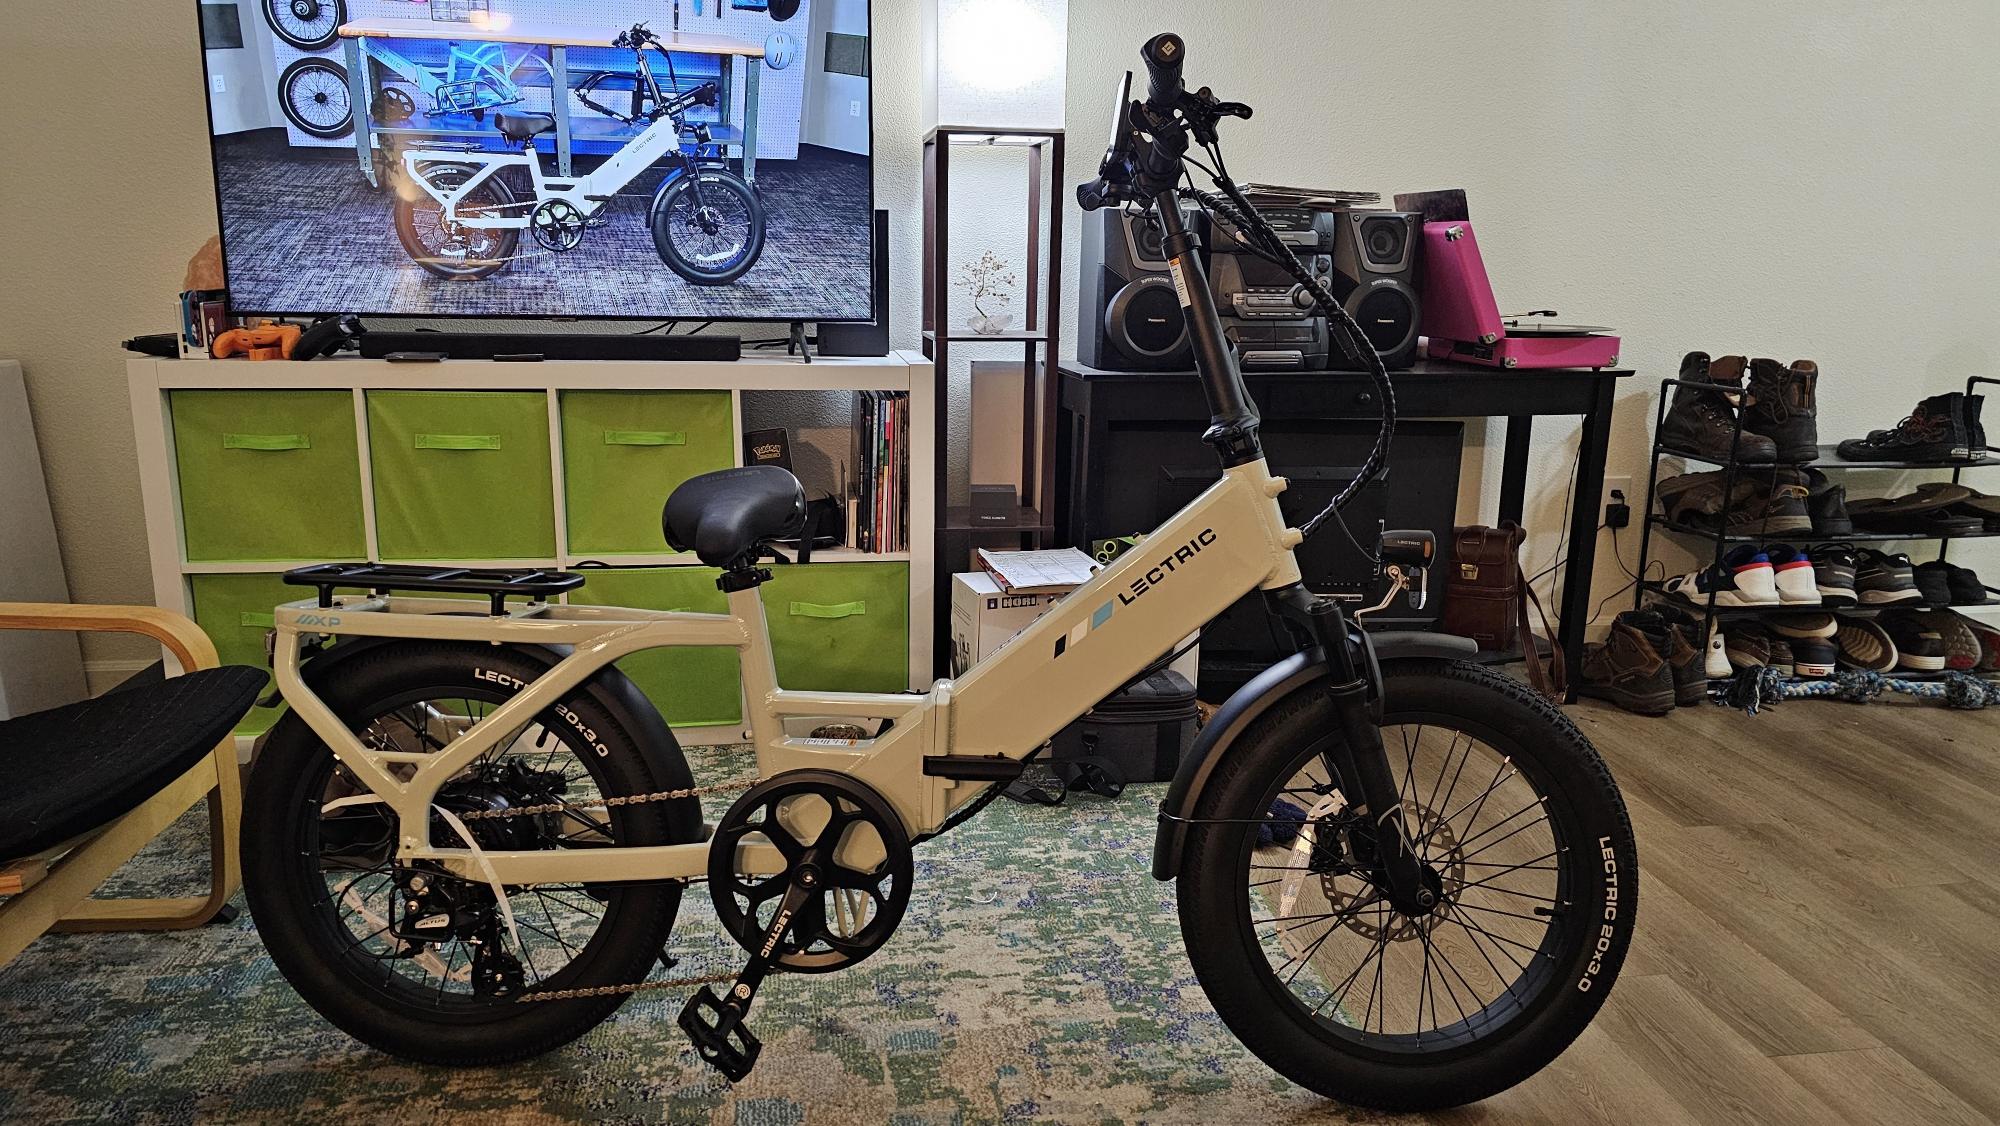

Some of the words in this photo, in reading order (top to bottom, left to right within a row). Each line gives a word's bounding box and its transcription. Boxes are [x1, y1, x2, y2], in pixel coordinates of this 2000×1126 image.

[667, 96, 696, 114] LECRIC
[632, 132, 657, 153] LECTRIC
[1117, 528, 1217, 606] LECTRIC
[474, 667, 530, 690] LECT
[554, 703, 609, 758] 20x3.0
[1598, 835, 1618, 921] LECTRIC
[760, 909, 792, 958] LECTRIC
[1577, 923, 1614, 993] 20x3.0
